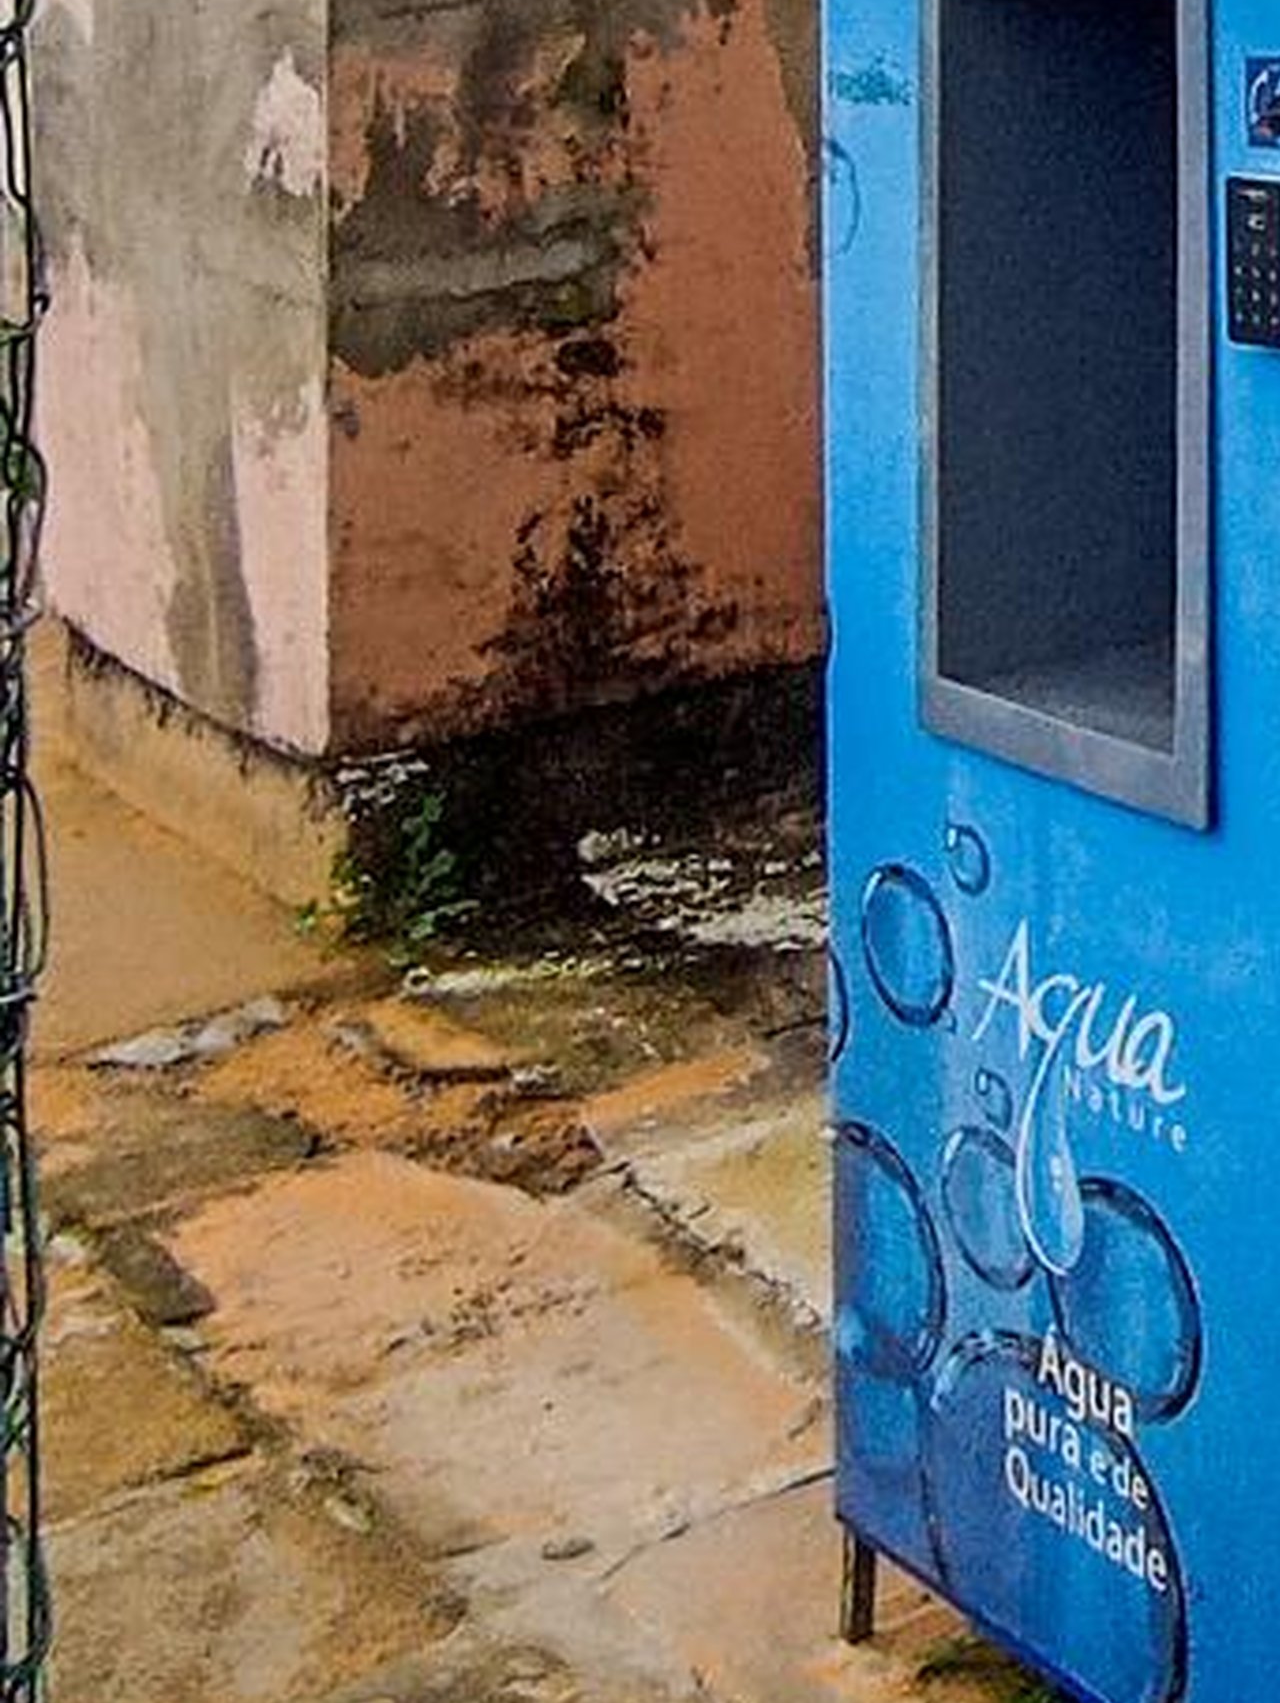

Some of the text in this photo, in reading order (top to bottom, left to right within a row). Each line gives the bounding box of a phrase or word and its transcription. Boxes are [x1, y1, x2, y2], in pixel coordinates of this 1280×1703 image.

[1064, 1064, 1187, 1153] Nature
[1038, 1322, 1135, 1438] Água
[1004, 1387, 1150, 1510] pura e de
[1004, 1444, 1169, 1592] Qualidade
